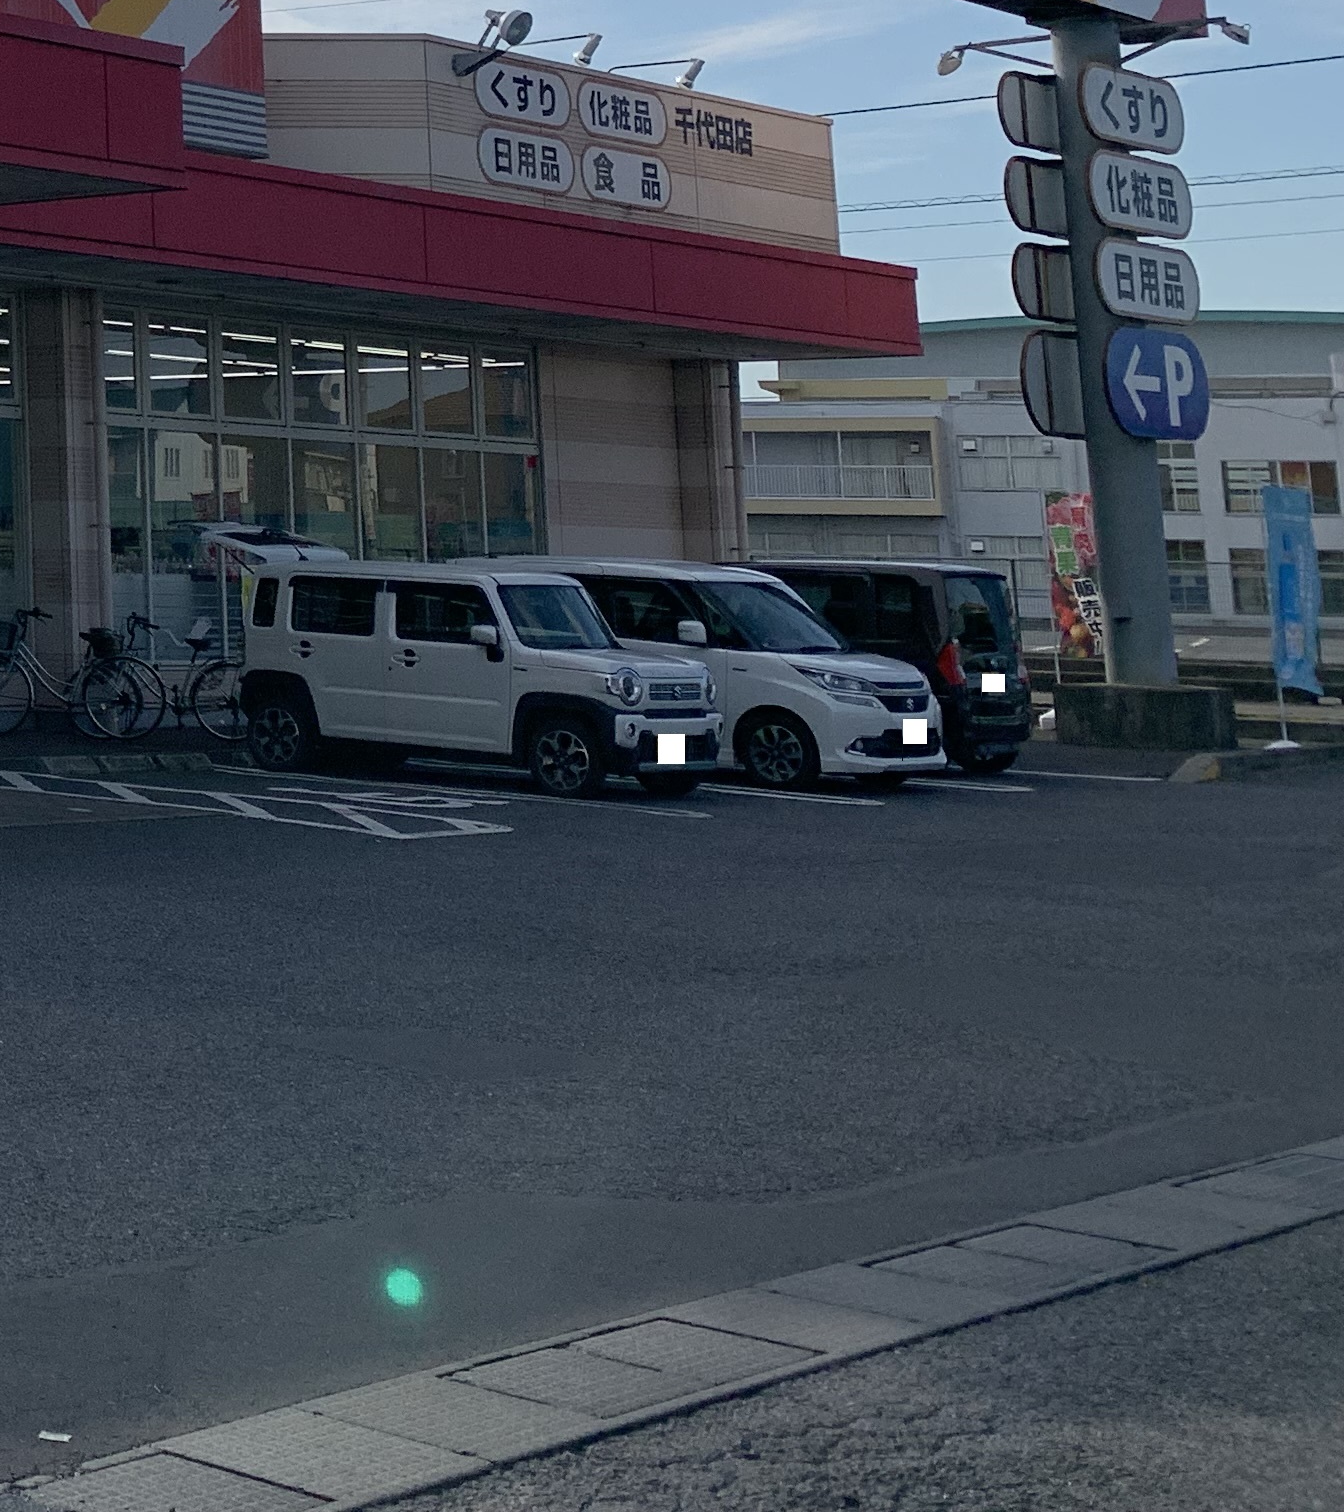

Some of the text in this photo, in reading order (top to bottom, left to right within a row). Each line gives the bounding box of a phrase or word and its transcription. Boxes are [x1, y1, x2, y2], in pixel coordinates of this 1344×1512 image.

[490, 70, 556, 117] くすり
[589, 90, 653, 136] 化粧品
[1100, 80, 1168, 138] くすり
[675, 106, 753, 157] 千代田店
[494, 137, 560, 183] 日用品
[1106, 164, 1179, 226] 化粧品
[1115, 254, 1185, 311] 日用品
[1164, 345, 1194, 427] P
